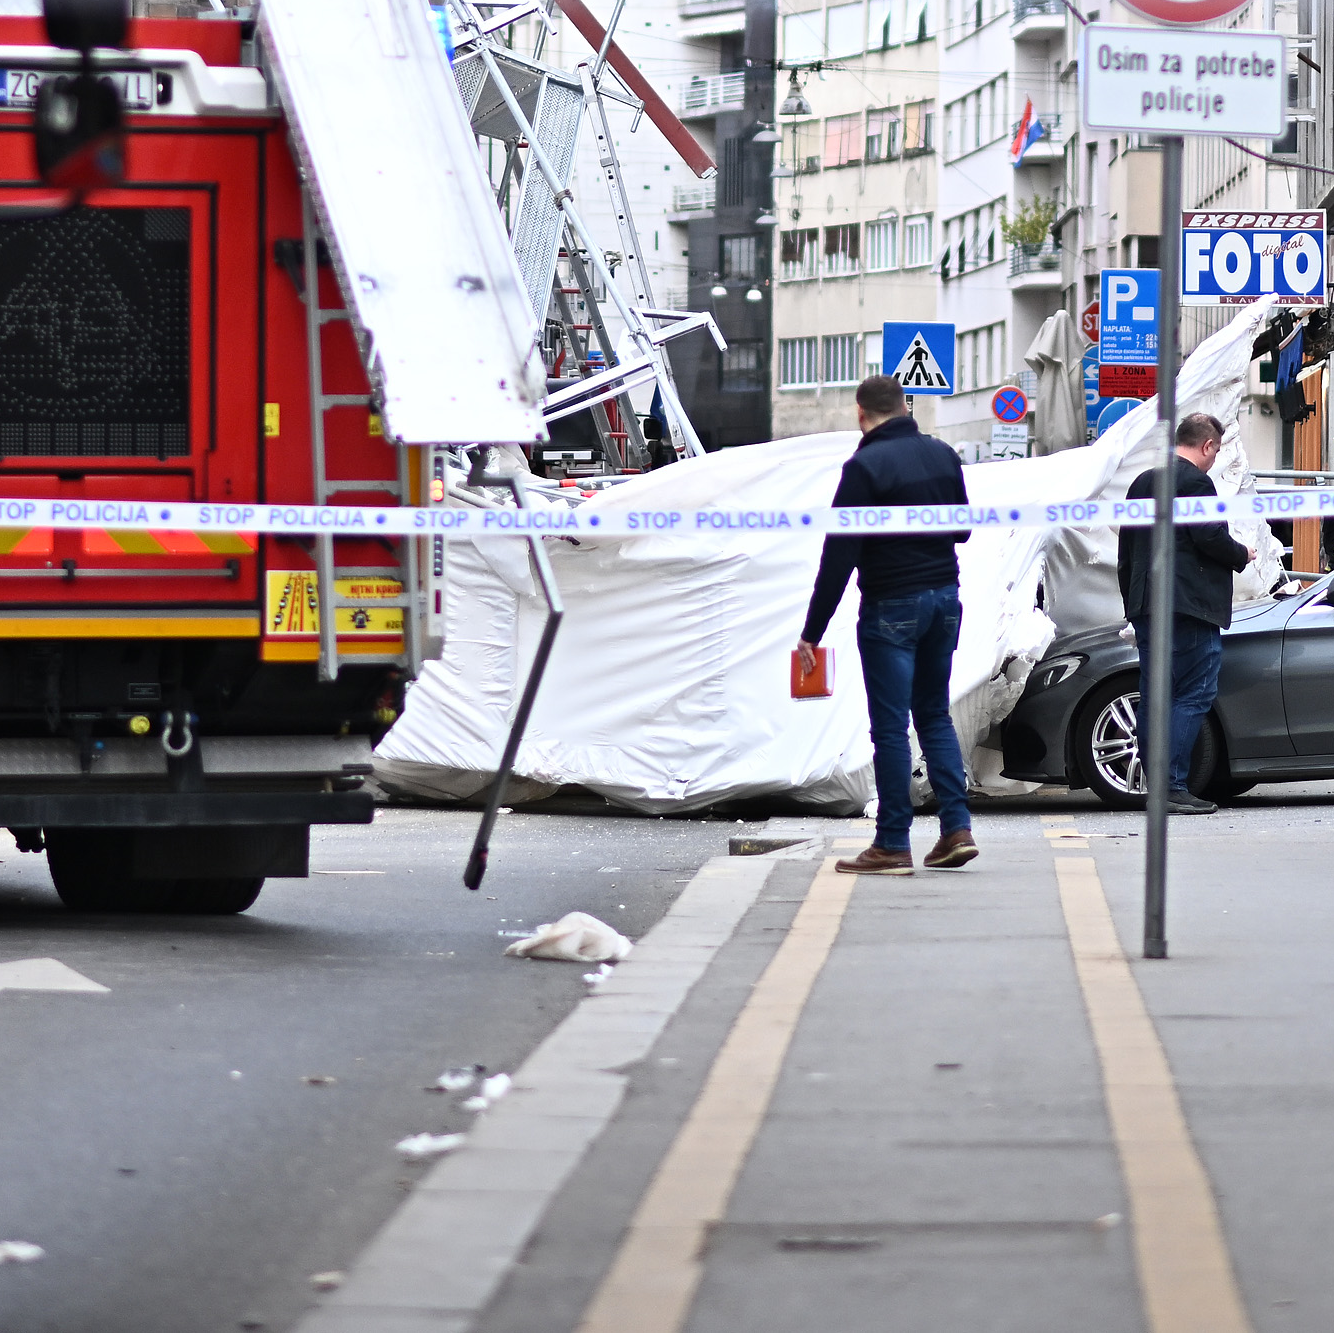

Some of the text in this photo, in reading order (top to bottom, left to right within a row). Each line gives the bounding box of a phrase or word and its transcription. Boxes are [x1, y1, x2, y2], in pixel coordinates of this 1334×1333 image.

[1098, 44, 1275, 81] Osim za potrebe
[1141, 86, 1224, 118] policije
[1187, 214, 1320, 228] EXSPRESS
[1261, 235, 1304, 259] digital
[1185, 231, 1322, 294] FOTO
[1108, 275, 1139, 320] P
[1084, 314, 1099, 330] ST
[1146, 333, 1154, 341] 22
[1123, 367, 1147, 375] ZONA
[51, 503, 149, 523] POLICIJA
[199, 506, 254, 524] STOP
[268, 507, 366, 526] POLICIJA
[414, 512, 469, 528] STOP
[484, 512, 579, 529] POLICIJA
[627, 512, 681, 528] STOP
[696, 511, 791, 529] POLICIJA
[839, 509, 891, 526] STOP
[906, 507, 1000, 525] POLICIJA
[1046, 503, 1098, 522] STOP
[1114, 498, 1206, 518] POLIJA
[1252, 494, 1304, 513] STOP
